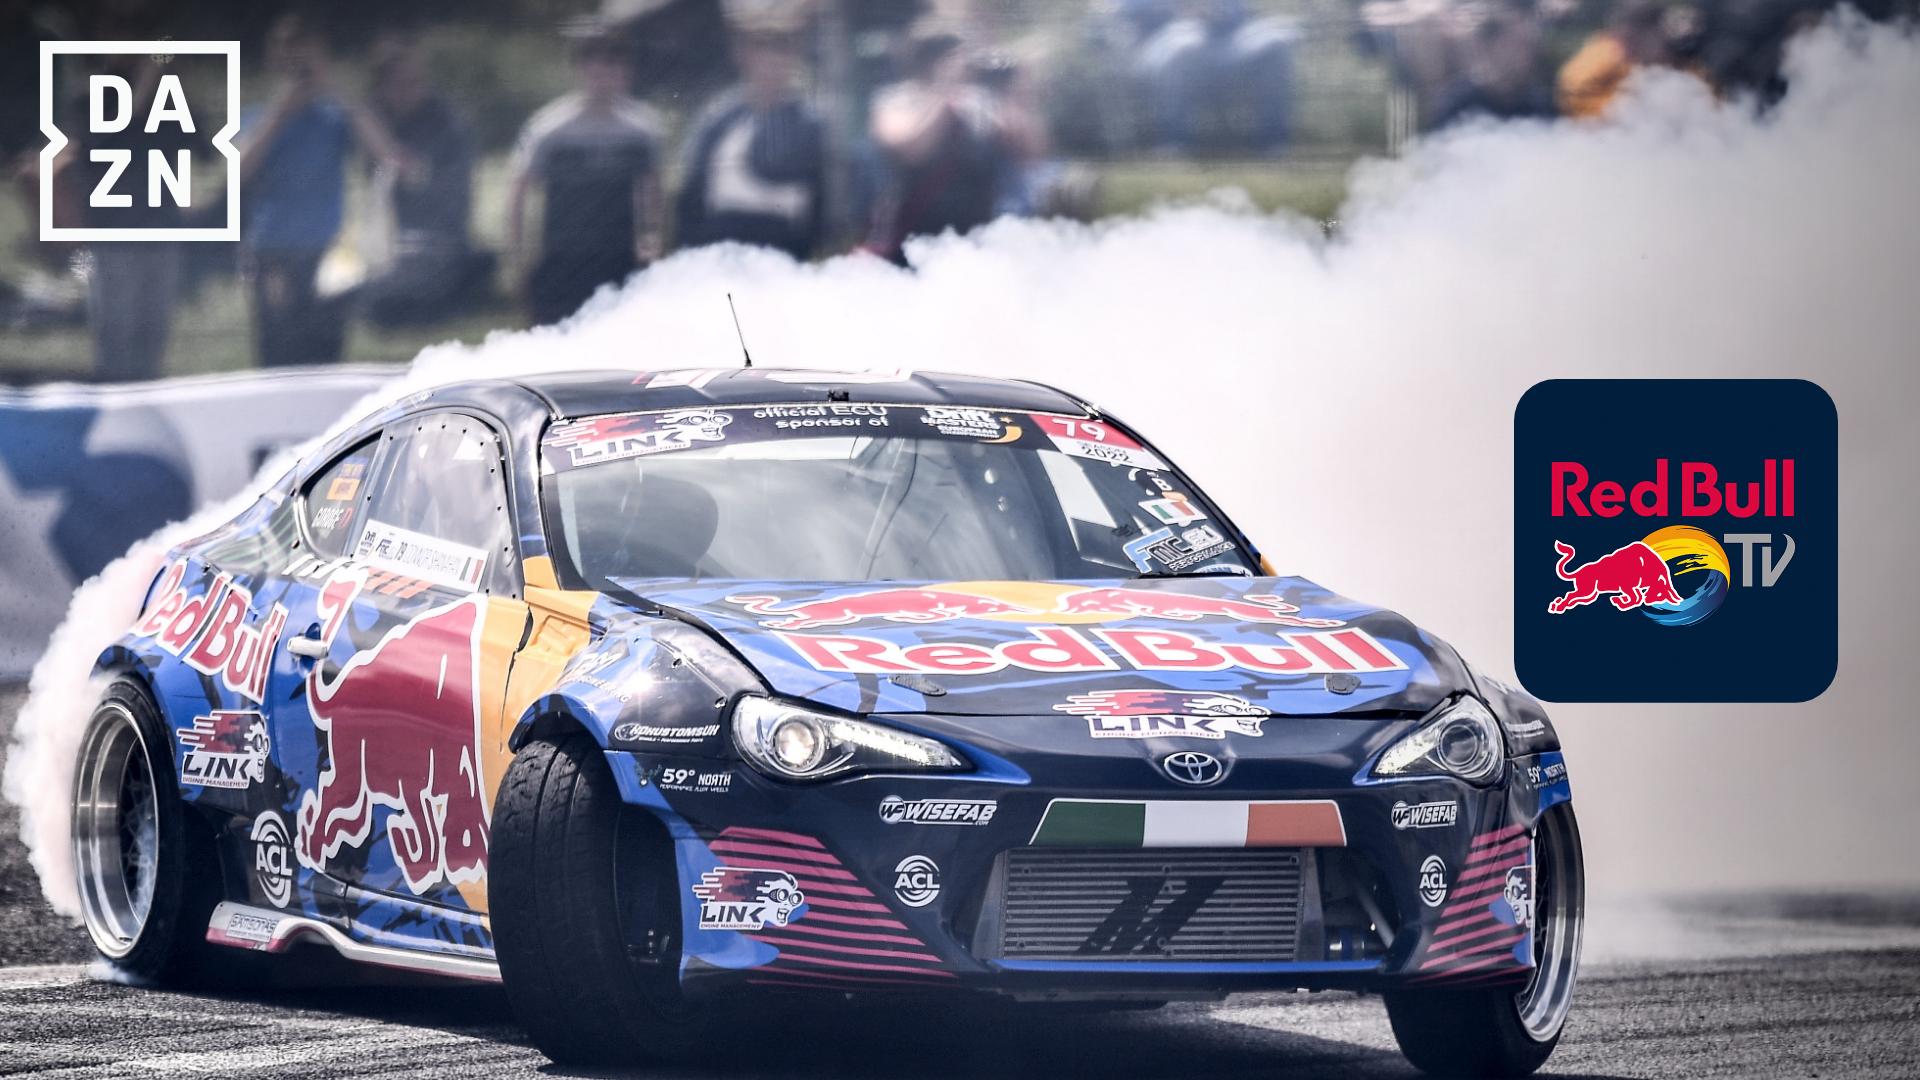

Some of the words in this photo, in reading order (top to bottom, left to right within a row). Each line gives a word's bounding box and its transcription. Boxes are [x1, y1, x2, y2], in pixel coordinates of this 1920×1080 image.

[753, 406, 827, 418] official
[829, 405, 887, 415] ECU
[775, 417, 861, 429] sponsor
[868, 415, 889, 426] of
[1051, 417, 1106, 442] 79
[573, 431, 683, 461] LINK
[1081, 445, 1133, 464] 2022
[1168, 541, 1235, 571] PERFORMANCE
[130, 559, 229, 655] Red
[185, 584, 287, 703] Bull
[786, 628, 1112, 672] Red
[1093, 630, 1404, 673] Bull
[1092, 717, 1219, 734] LINK
[183, 754, 251, 779] LINK
[1527, 765, 1541, 783] 59°
[661, 768, 696, 785] 59°
[698, 774, 732, 786] NORTH
[905, 803, 998, 821] WISEFAB
[1410, 806, 1457, 824] WISEFAB
[256, 843, 293, 877] ACL
[894, 873, 940, 889] ACL
[1419, 873, 1447, 889] ACL
[701, 905, 767, 923] LINK
